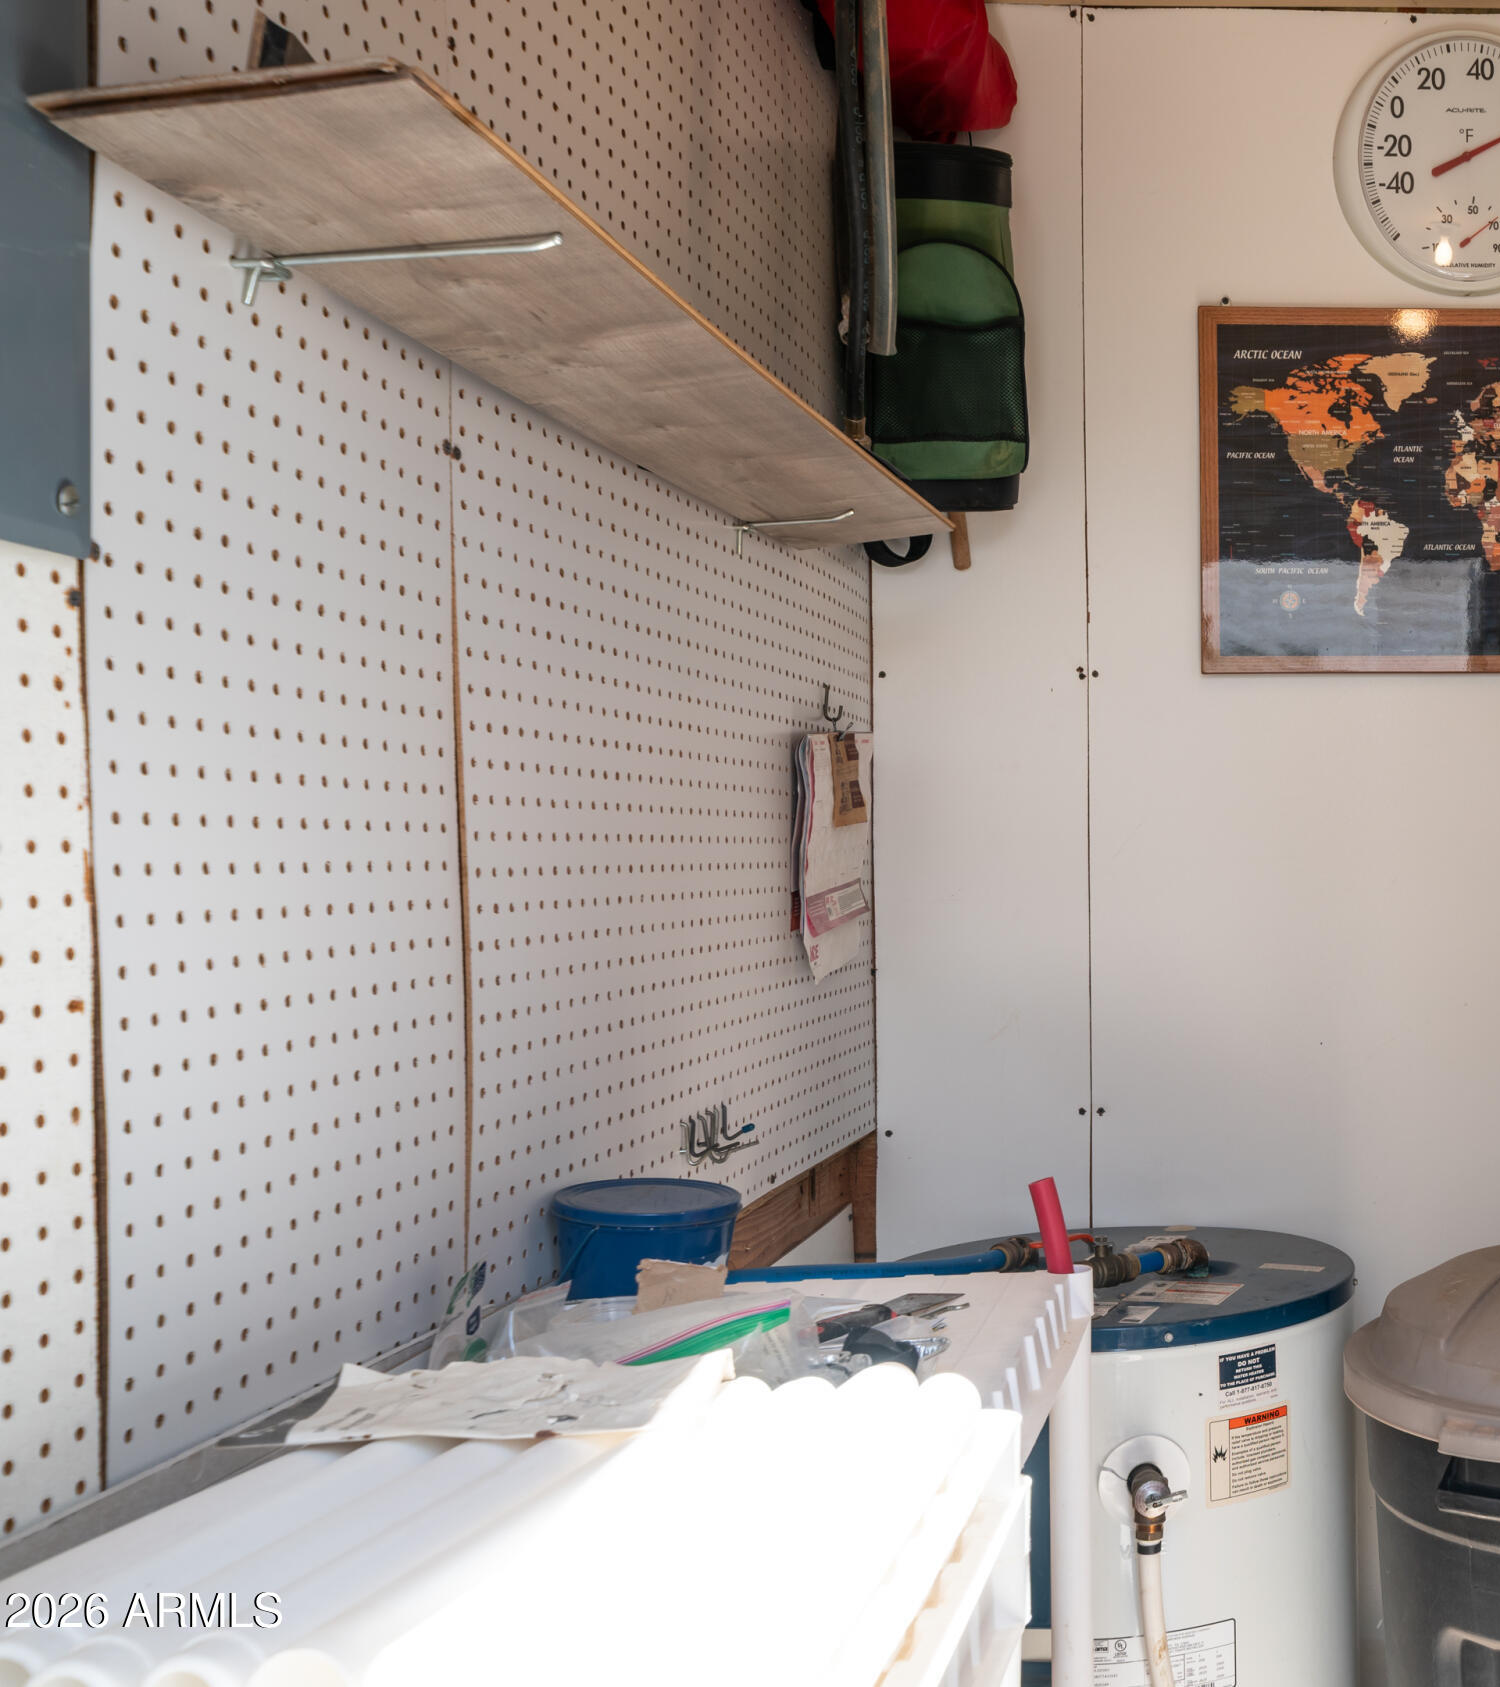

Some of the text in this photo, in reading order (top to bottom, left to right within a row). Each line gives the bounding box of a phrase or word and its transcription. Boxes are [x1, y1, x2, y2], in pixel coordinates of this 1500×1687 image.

[1466, 58, 1495, 81] 40
[1416, 67, 1446, 90] 20
[1390, 96, 1404, 118] 0
[1459, 128, 1474, 143] °F
[1377, 134, 1412, 158] -20
[1378, 171, 1415, 194] -40
[1468, 205, 1479, 214] 50
[1441, 214, 1452, 224] 30
[1488, 221, 1499, 230] 70
[1233, 350, 1302, 359] ARCTIC OCEAN
[1244, 1410, 1280, 1424] WARNING
